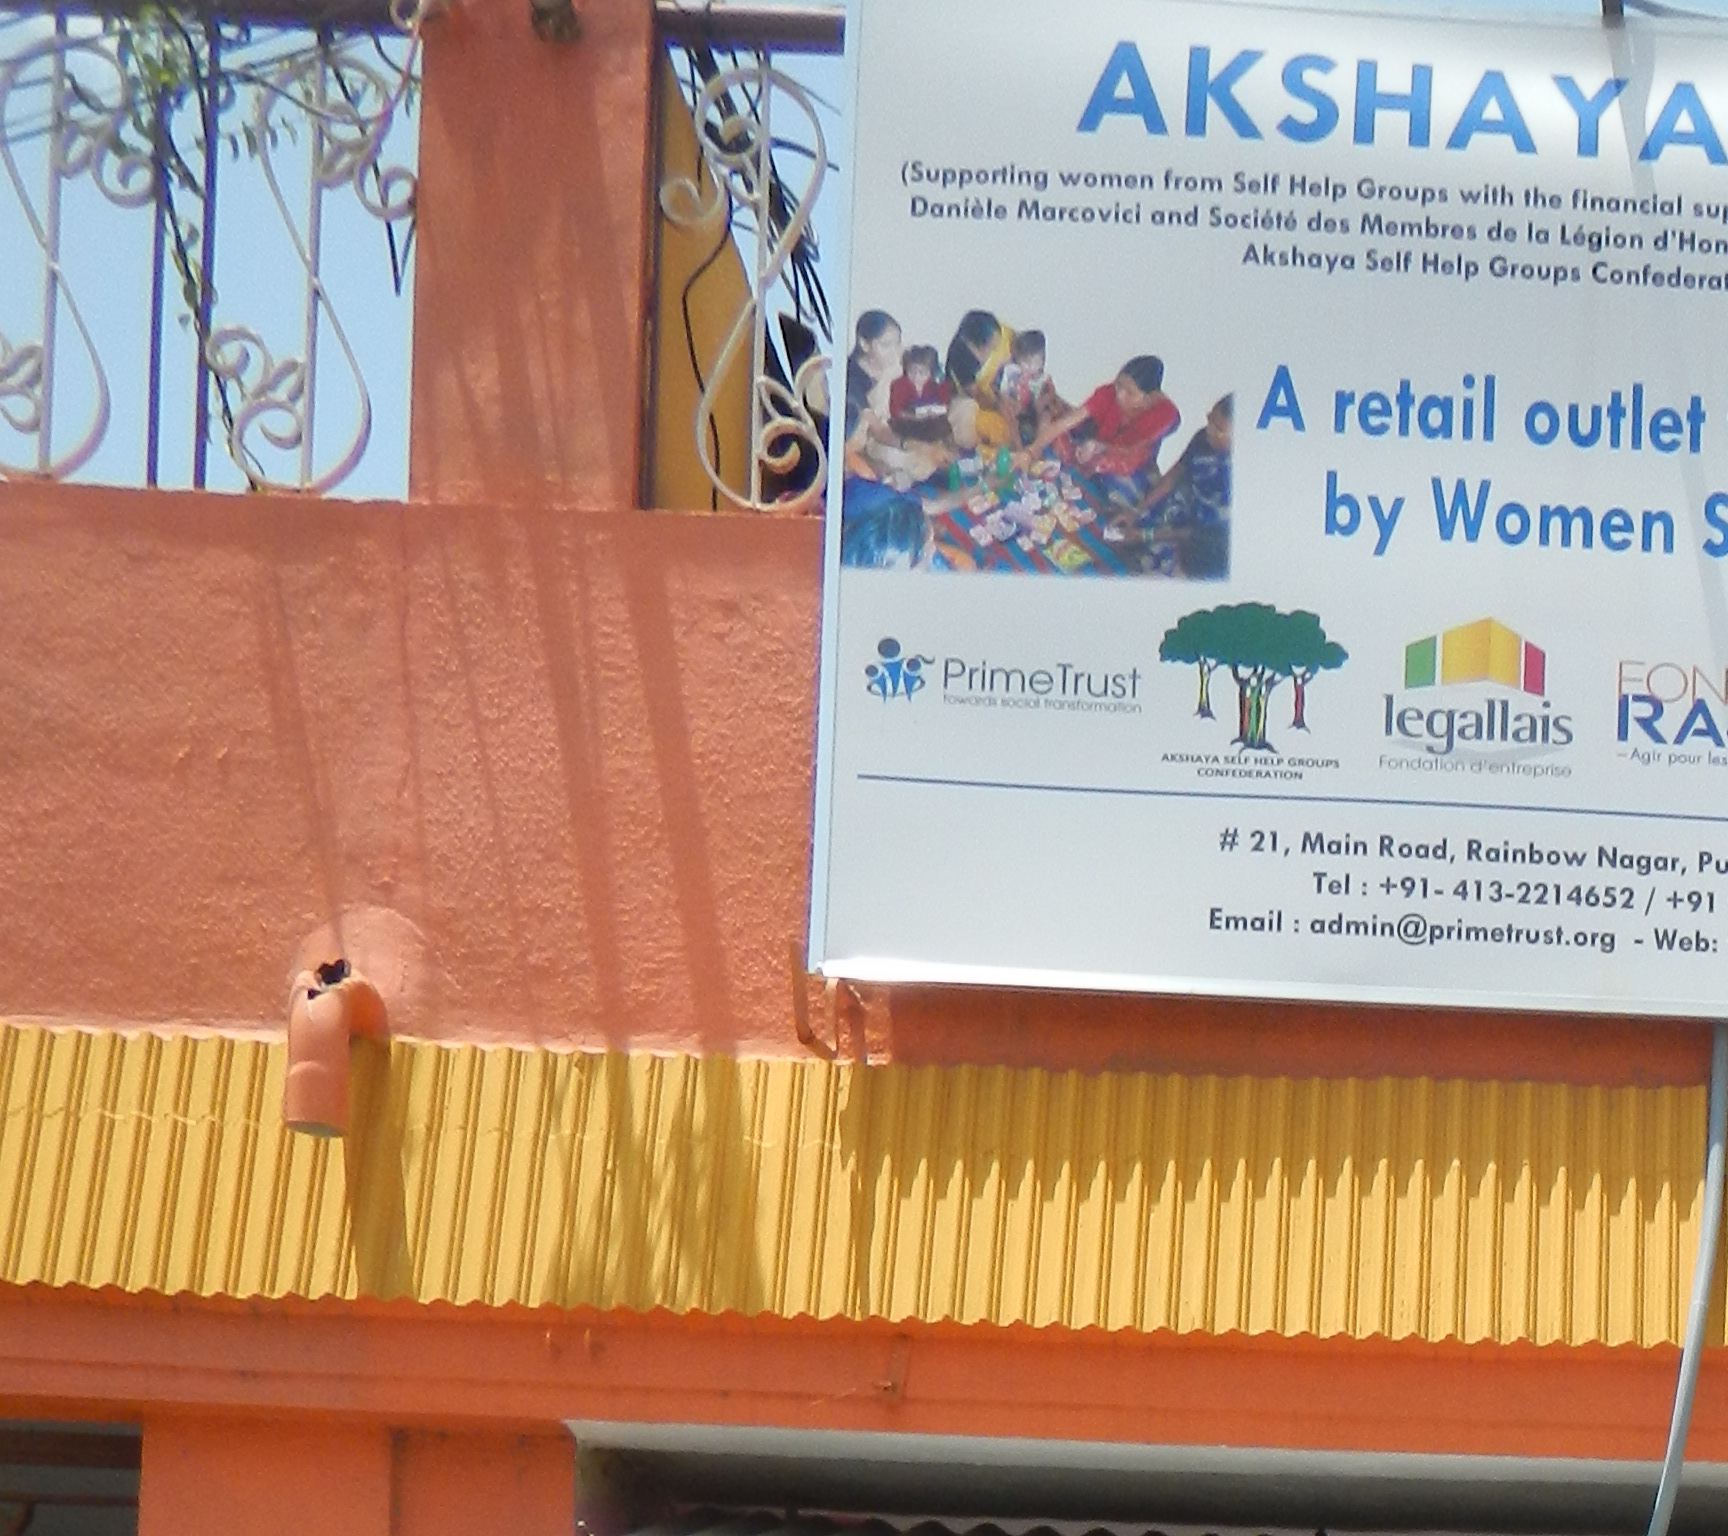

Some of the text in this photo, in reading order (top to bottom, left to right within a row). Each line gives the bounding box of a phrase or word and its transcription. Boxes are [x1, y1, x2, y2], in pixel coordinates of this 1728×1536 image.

[1076, 41, 1728, 166] AKSHAYA
[901, 160, 1048, 192] (Supporting
[1059, 172, 1154, 191] women
[1164, 168, 1223, 193] from
[1233, 171, 1280, 196] Self
[1289, 174, 1347, 205] Help
[1357, 176, 1449, 209] Groups
[1459, 183, 1514, 207] with
[1524, 185, 1562, 210] the
[1571, 188, 1684, 219] financial
[911, 195, 1007, 221] Danièle
[1017, 198, 1141, 225] Marcovici
[1151, 204, 1199, 227] and
[1209, 203, 1297, 232] Société
[1307, 208, 1350, 235] des
[1360, 211, 1477, 242] Membres
[1487, 217, 1517, 244] de
[1527, 219, 1550, 246] la
[1559, 221, 1644, 254] Légion
[1242, 242, 1355, 275] Akshaya
[1365, 245, 1412, 274] Self
[1422, 249, 1479, 282] Help
[1489, 254, 1581, 287] Groups
[1256, 364, 1306, 433] A
[1334, 373, 1496, 443] retail
[1524, 382, 1706, 455] outlet
[1324, 469, 1405, 557] by
[1431, 476, 1674, 555] Women
[943, 657, 1141, 699] PrimeTrust
[1383, 693, 1575, 755] legallais
[1161, 753, 1220, 765] AKSHAYA
[1287, 757, 1340, 769] GROUPS
[1197, 767, 1303, 780] CONFEDERATION
[1378, 754, 1465, 772] Fondation
[1668, 752, 1702, 768] pour
[1250, 830, 1290, 857] 21,
[1301, 831, 1367, 856] Main
[1379, 834, 1455, 865] Road,
[1467, 838, 1587, 867] Rainbow
[1598, 845, 1687, 877] Nagar,
[1313, 871, 1350, 896] Tel
[1379, 876, 1444, 900] +91-
[1453, 879, 1634, 910] 413-2214652
[1666, 890, 1714, 913] +91
[1209, 907, 1282, 933] Email
[1310, 912, 1615, 954] admin@primetrust.org
[1654, 927, 1718, 953] Web:
